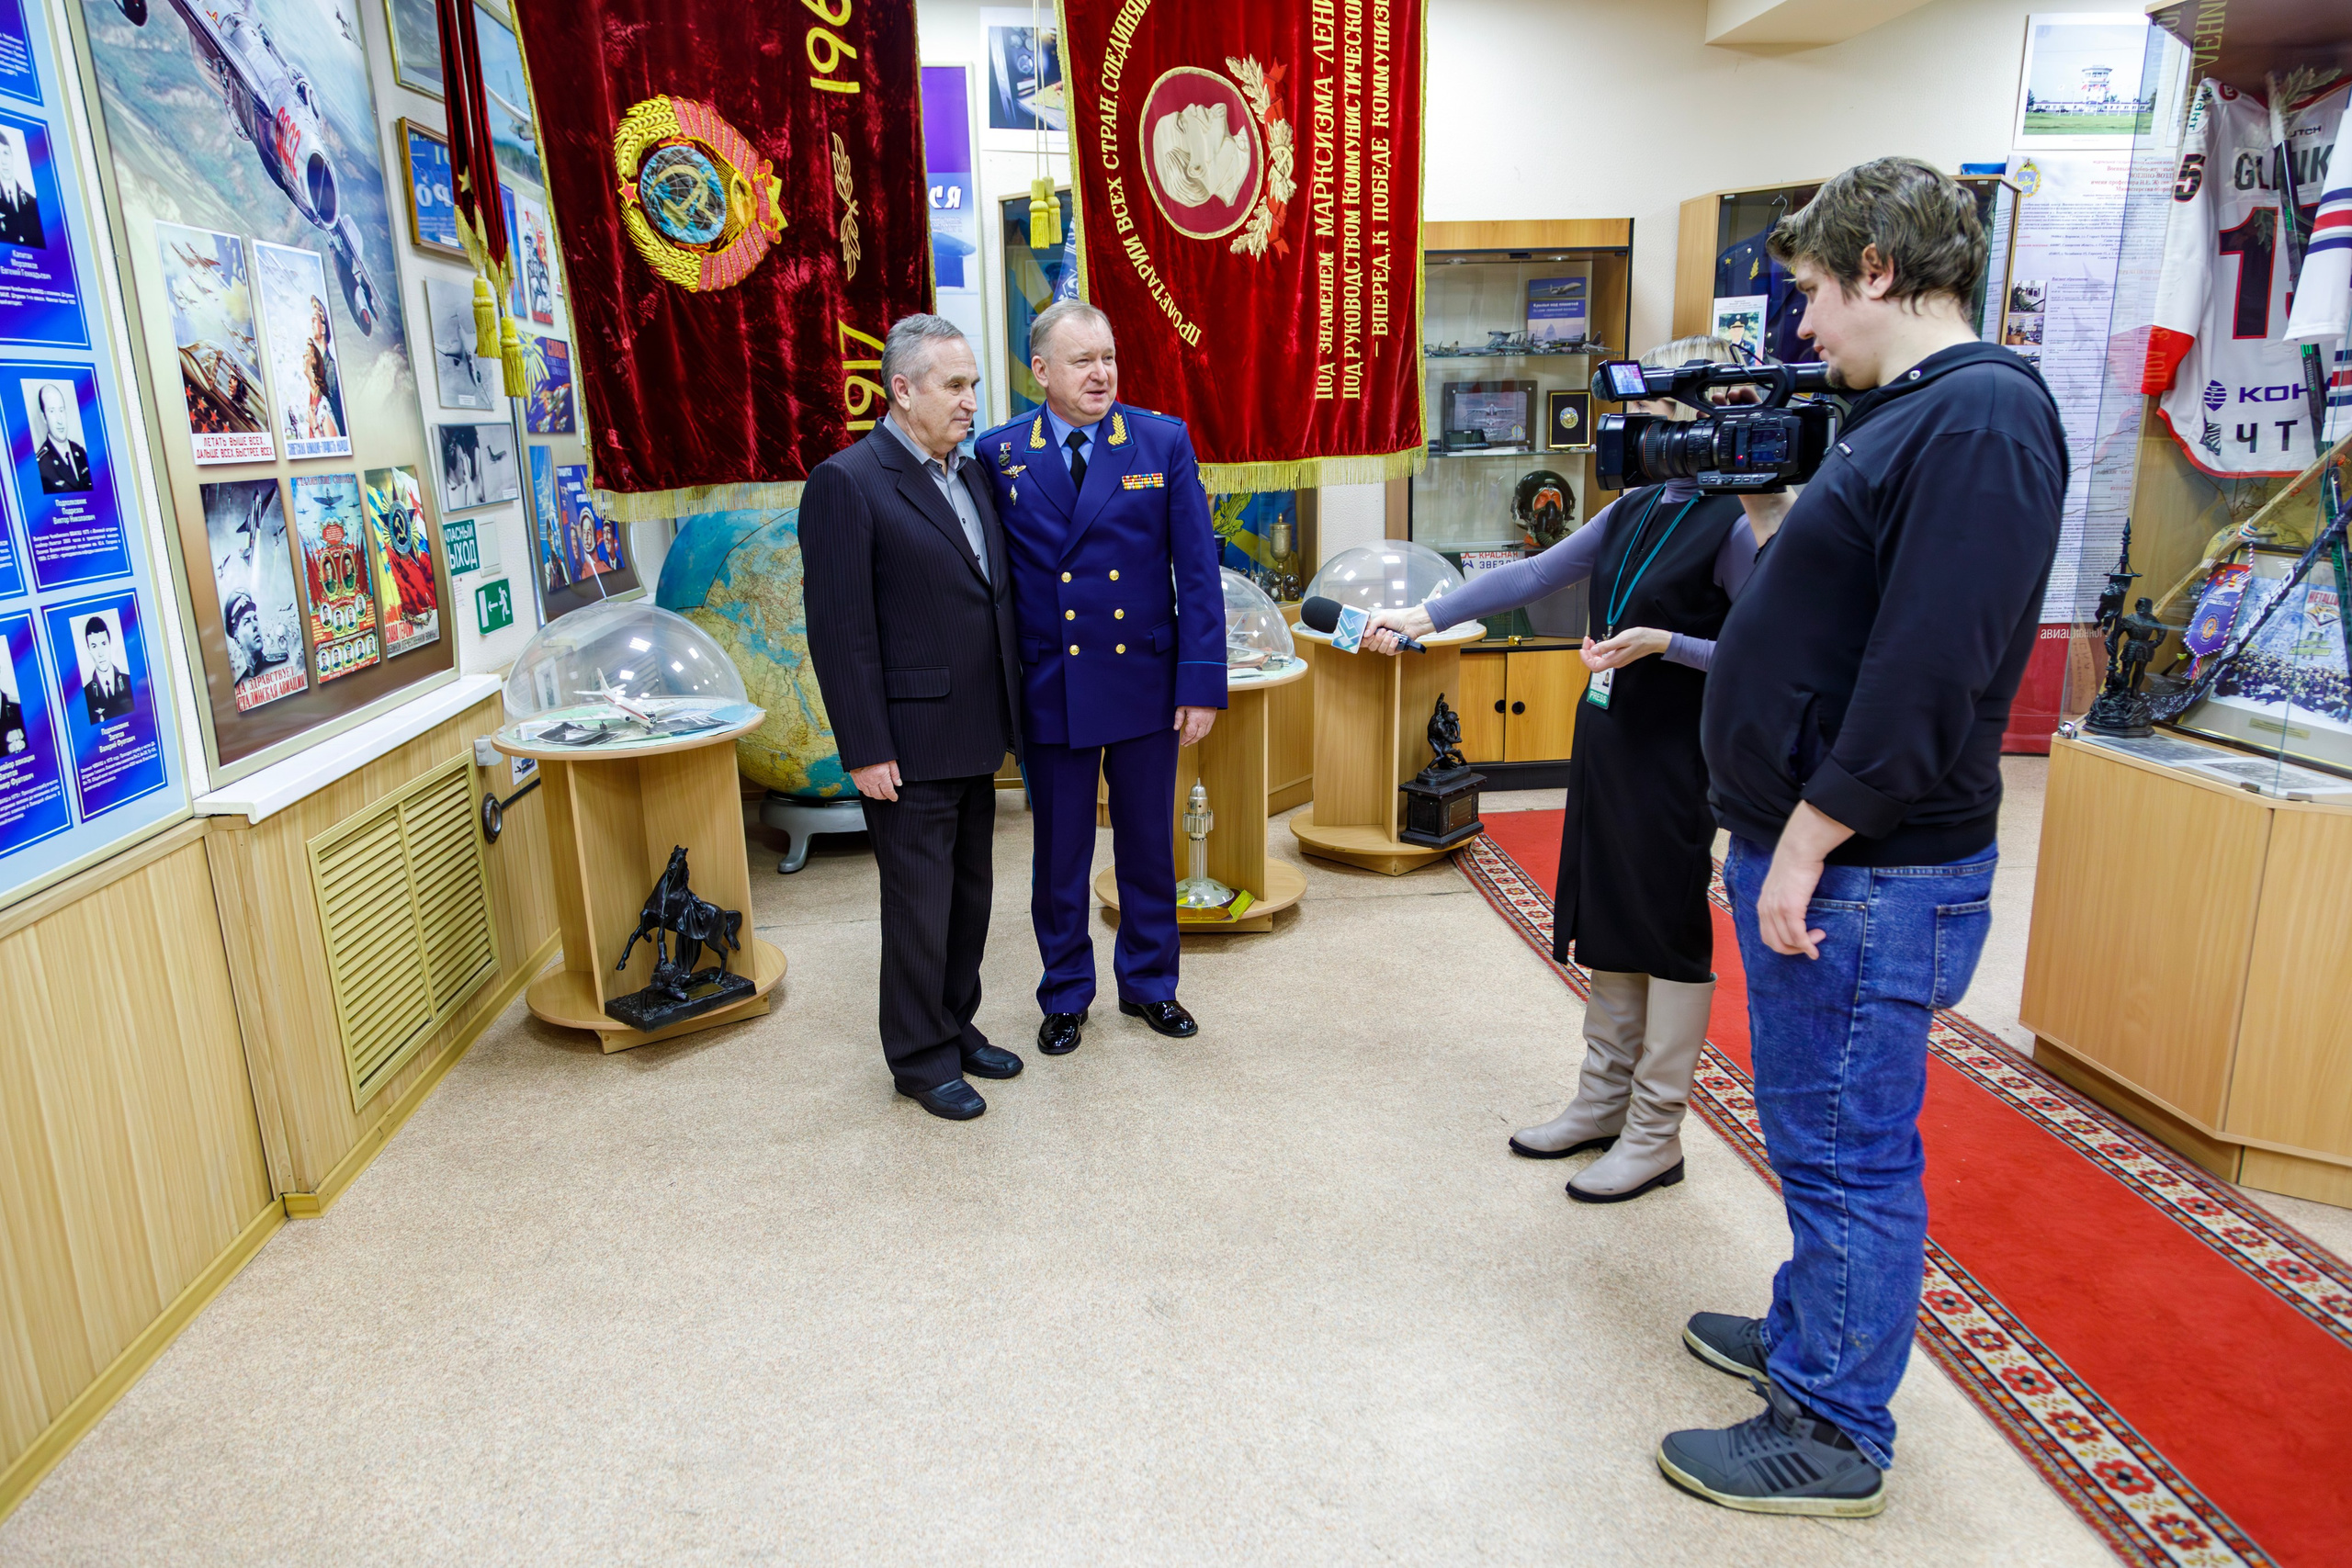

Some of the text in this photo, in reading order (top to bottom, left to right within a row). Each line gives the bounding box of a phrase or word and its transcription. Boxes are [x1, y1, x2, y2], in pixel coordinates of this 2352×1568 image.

[1372, 0, 1391, 129] КОММУНИЗ
[1100, 93, 1120, 170] СТРАН,
[1372, 138, 1391, 221] ПОБЕДЕ
[1107, 176, 1133, 235] ВСЕХ
[1372, 231, 1389, 246] К
[1123, 233, 1202, 347] ПРОЛЕТАРИИ
[1318, 251, 1334, 355] ЗНАМЕНЕМ
[1343, 209, 1363, 358] РУКОВОДСТВОМ
[1372, 248, 1391, 336] ВПЕРЕД,
[838, 318, 888, 431] 1917
[1315, 362, 1336, 400] ПОД
[1342, 361, 1363, 400] ПОД
[197, 448, 219, 458] ДАЛЬШЕ
[235, 447, 259, 457] БЫСТРЕЕ
[204, 437, 227, 446] ЛЕТАТЬ
[229, 436, 247, 446] ВЫШЕ
[447, 539, 479, 570] ЫХОД
[235, 666, 294, 695] ДА ЗДРАВСТВУЕТ
[237, 671, 307, 712] СТАЛИНСКАЯ АВИАЦИЯ!
[1589, 690, 1608, 704] PRESS
